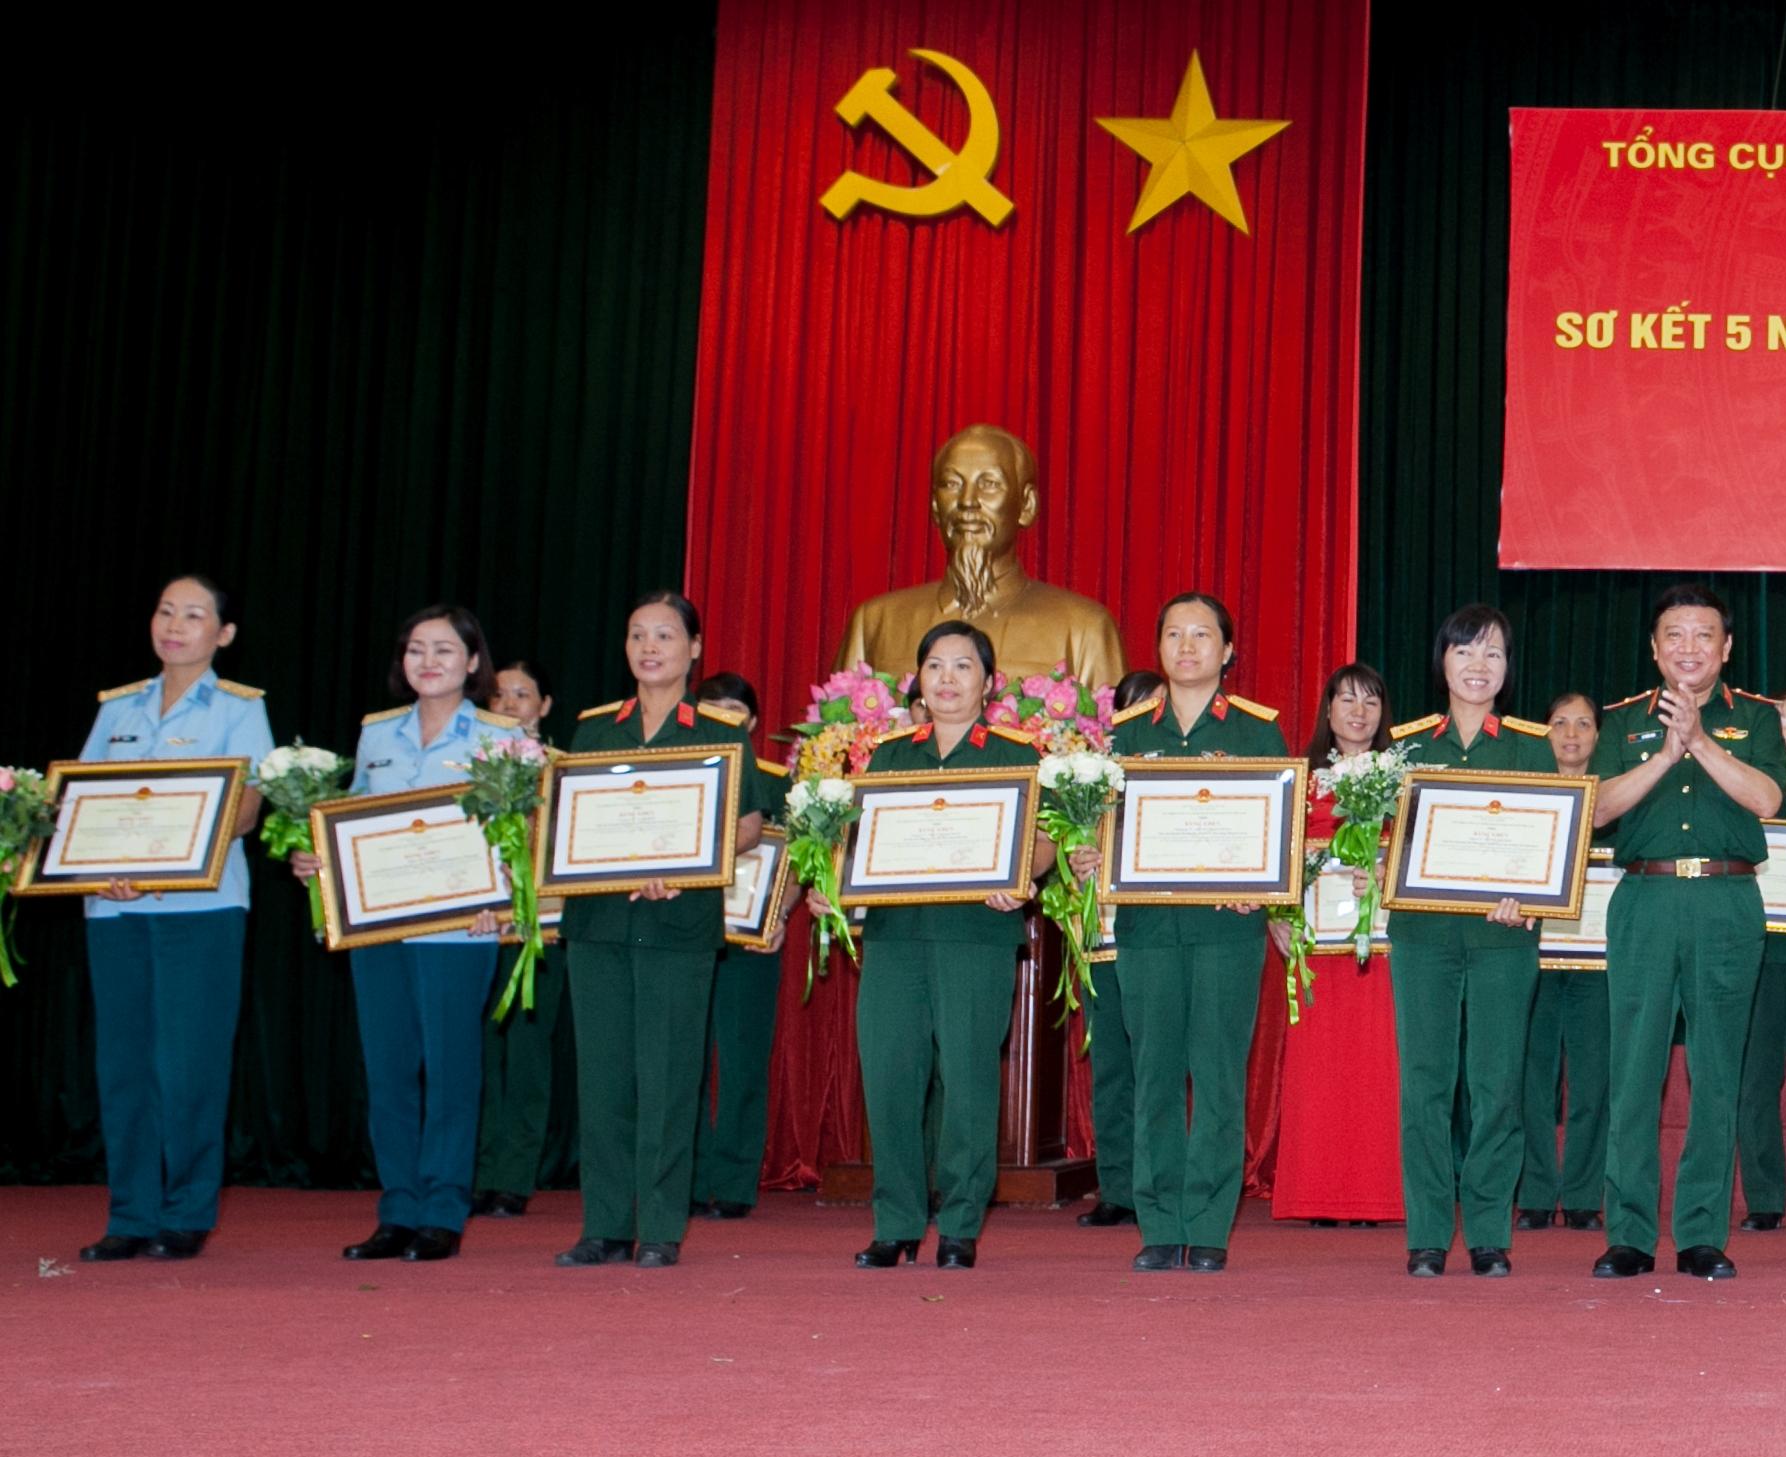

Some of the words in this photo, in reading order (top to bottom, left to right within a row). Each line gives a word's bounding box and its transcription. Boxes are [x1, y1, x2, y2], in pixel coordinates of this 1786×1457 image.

[1602, 126, 1715, 169] TỔNG
[1555, 309, 1619, 349] SƠ
[1630, 300, 1712, 350] KẾT
[1725, 314, 1752, 351] 5
